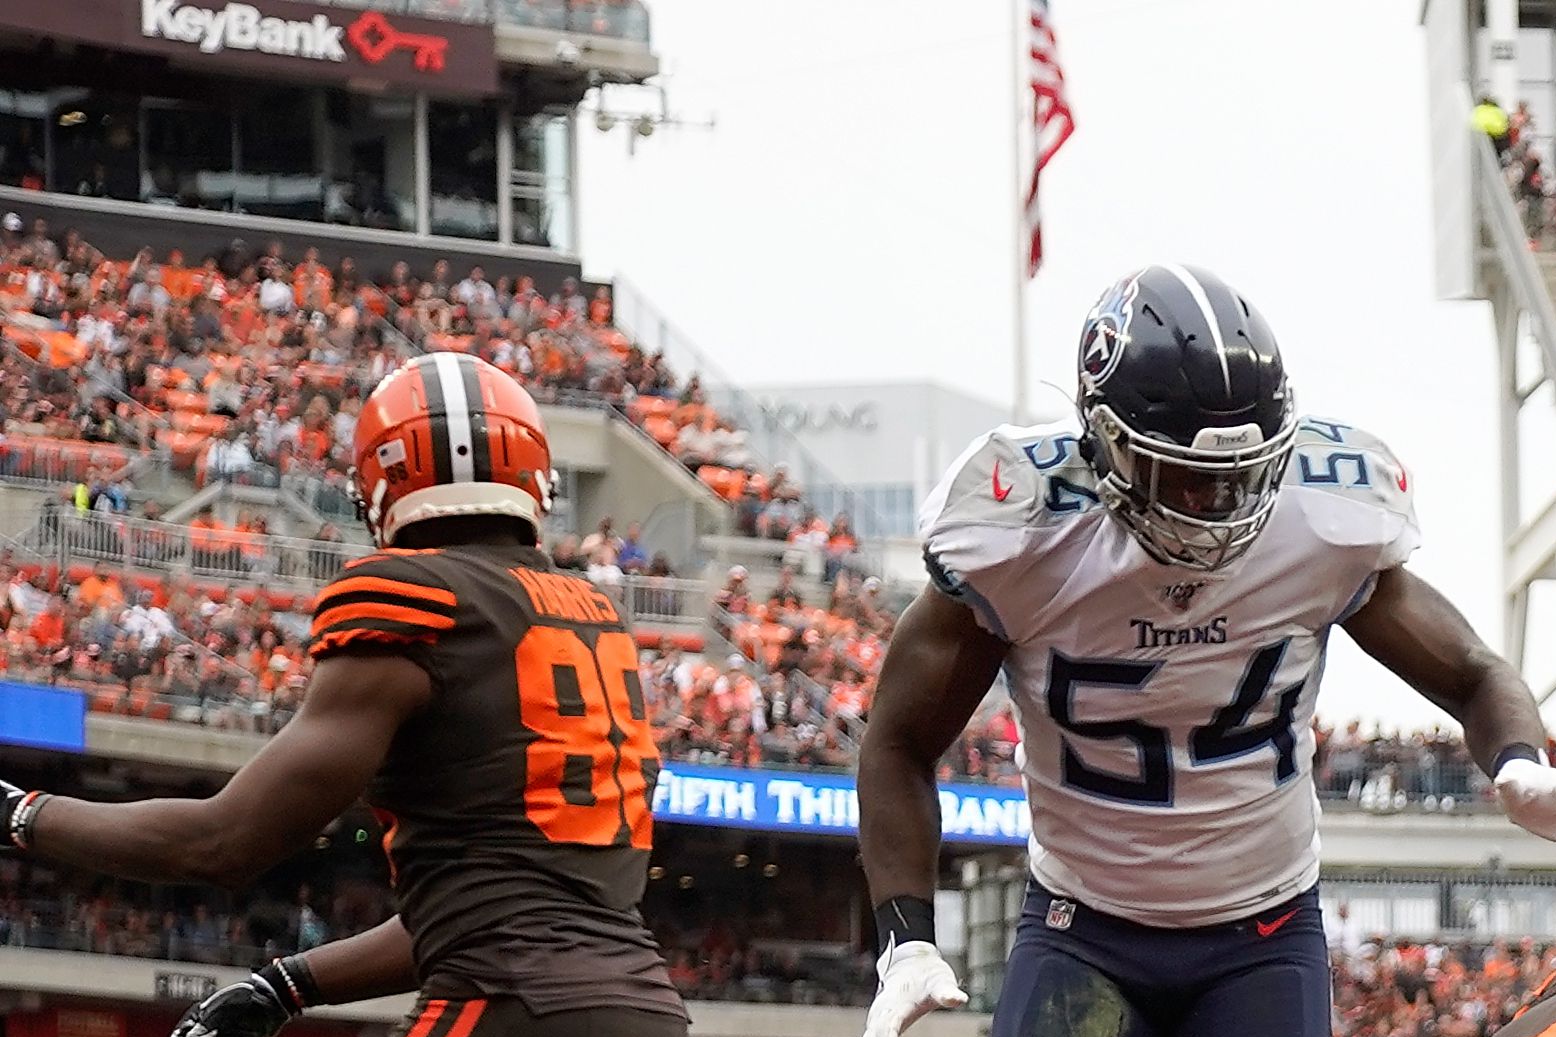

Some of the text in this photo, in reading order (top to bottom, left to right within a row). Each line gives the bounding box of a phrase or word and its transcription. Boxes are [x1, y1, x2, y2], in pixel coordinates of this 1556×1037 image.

[141, 0, 347, 62] KeyBank
[1130, 616, 1227, 648] TITANS
[1044, 636, 1306, 808] 54
[653, 769, 756, 821] FIFTH
